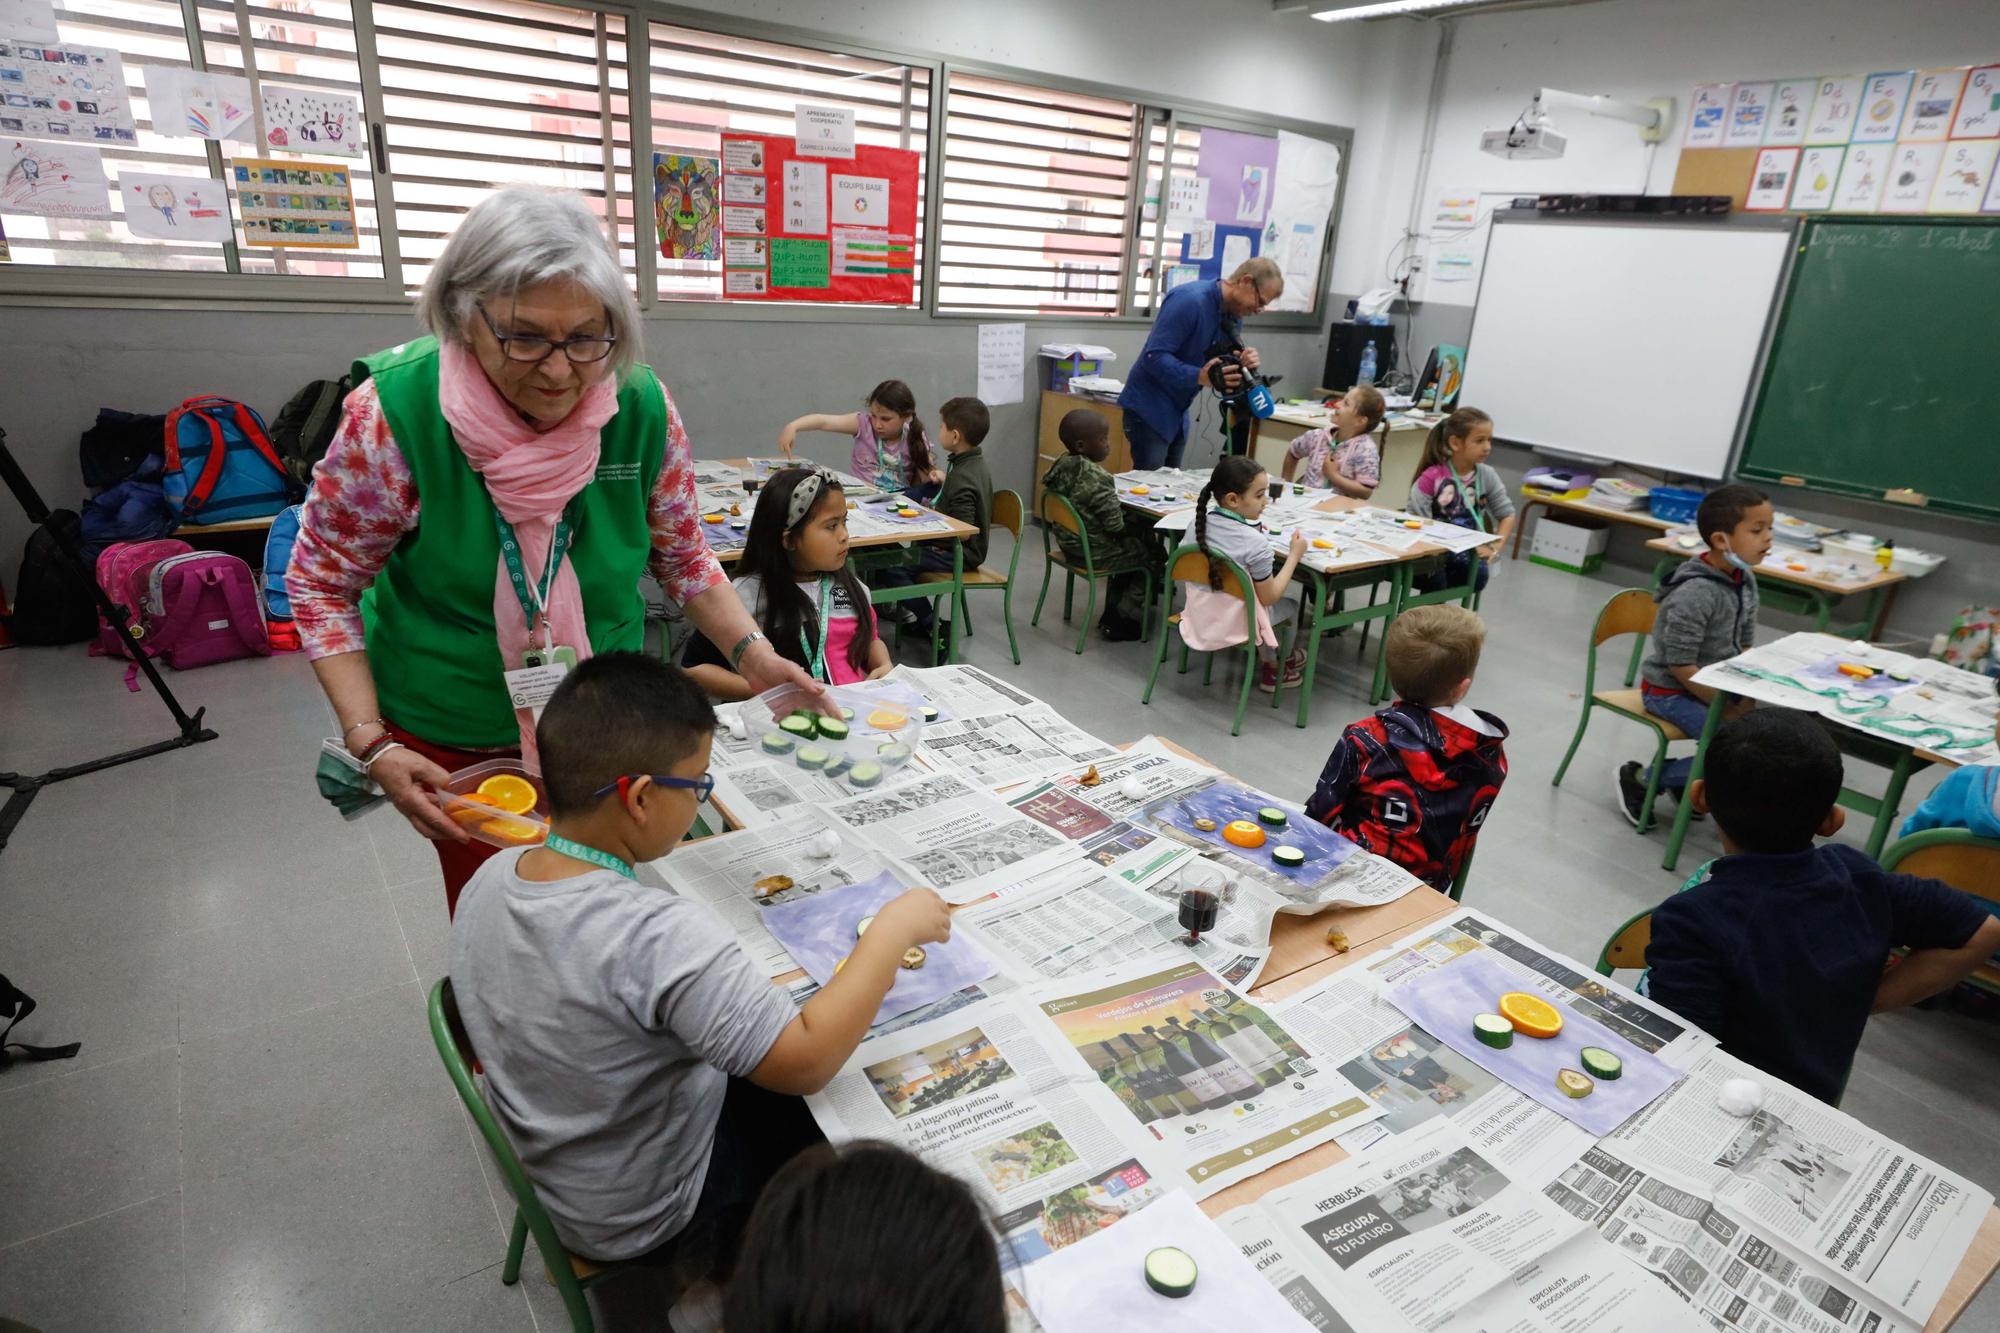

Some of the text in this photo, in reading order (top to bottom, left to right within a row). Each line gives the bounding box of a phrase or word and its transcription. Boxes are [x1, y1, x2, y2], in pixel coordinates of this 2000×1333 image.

[1823, 83, 1833, 96] D
[1874, 80, 1885, 93] E
[1922, 77, 1934, 90] F
[1974, 73, 1986, 87] G
[1699, 92, 1707, 103] A
[839, 181, 883, 191] EQUIPS BASE
[1132, 756, 1170, 772] IBIZA
[921, 1106, 965, 1126] lagartija
[966, 1092, 999, 1112] pitiusa
[908, 1100, 1015, 1146] es clave para prevenir
[949, 1131, 962, 1141] de
[1408, 1160, 1420, 1168] ES
[1885, 1155, 1904, 1182] vacunación
[1909, 1163, 1921, 1174] Las
[1894, 1168, 1914, 1196] patronales
[1934, 1179, 1960, 1206] Ibiza
[1315, 1185, 1365, 1213] HERBUSA
[1858, 1193, 1880, 1214] Ejército
[1880, 1191, 1900, 1217] pitiusas
[1322, 1212, 1380, 1244] ASEGURA
[1452, 1211, 1491, 1235] ESPECIALISTA
[1871, 1210, 1887, 1230] piden
[1906, 1203, 1934, 1241] Formentera
[1332, 1222, 1394, 1256] TU FUTURO
[1839, 1222, 1858, 1243] clínicas
[1854, 1232, 1875, 1255] Govern
[1368, 1252, 1408, 1279] ESPECIALISTA
[1530, 1277, 1568, 1304] ESPECIALISTA
[1537, 1274, 1591, 1312] RECOGIDA RESIDUOS
